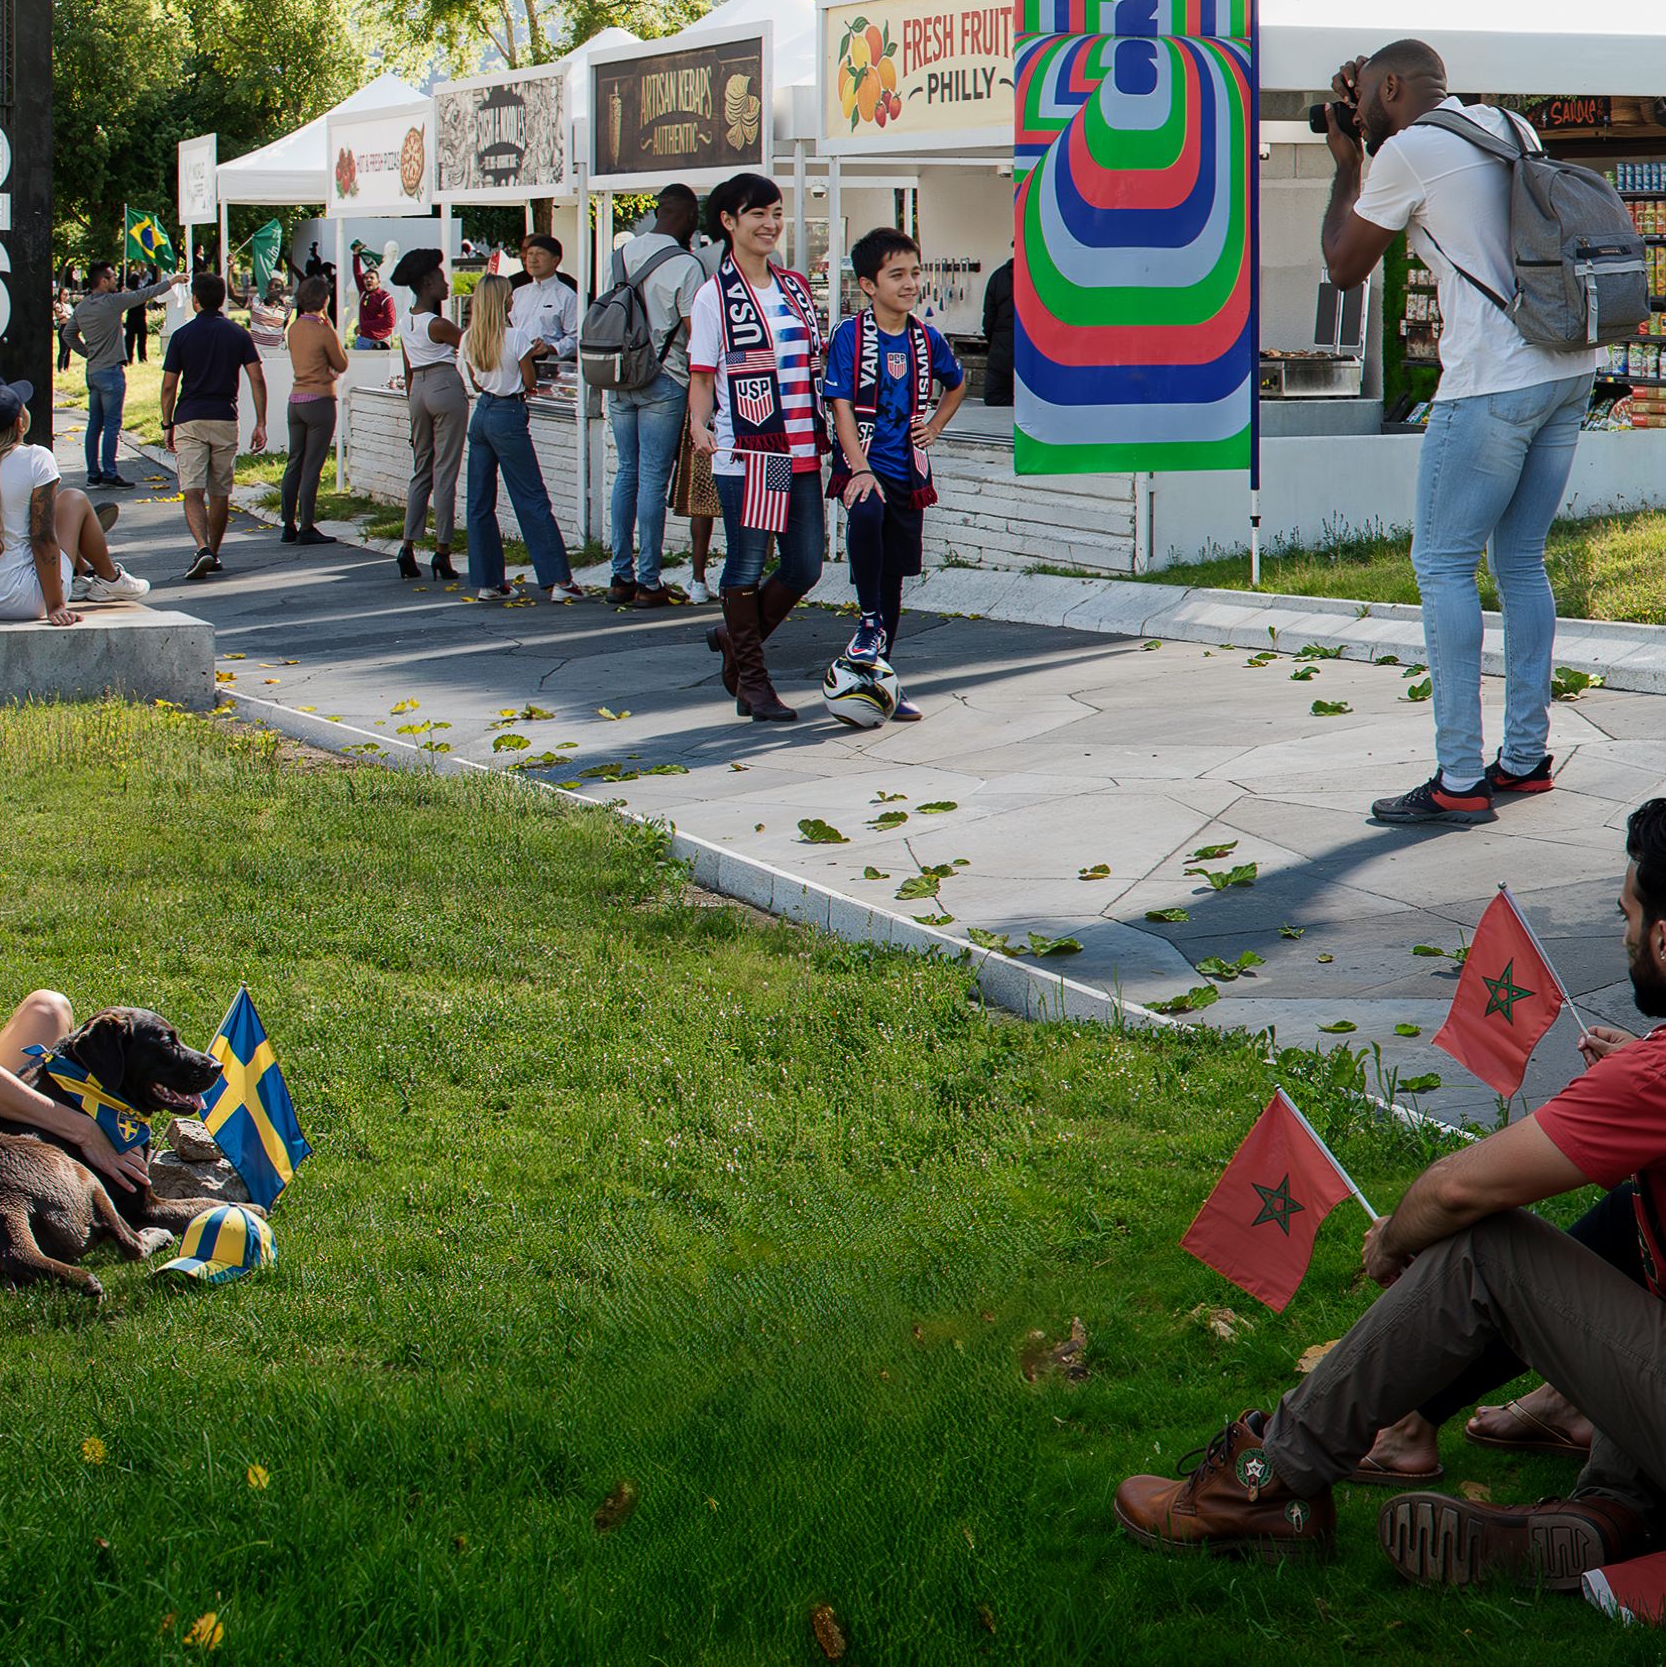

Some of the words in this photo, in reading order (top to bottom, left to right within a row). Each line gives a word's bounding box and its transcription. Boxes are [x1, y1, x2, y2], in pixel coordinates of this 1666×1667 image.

[903, 14, 954, 78] FRESH
[961, 6, 1014, 59] FRUIT
[640, 70, 676, 130] ARTISAN
[678, 65, 712, 120] KEBAPS
[928, 66, 996, 104] PHILLY
[653, 122, 698, 156] AUTHENTIC
[727, 283, 763, 346] USA
